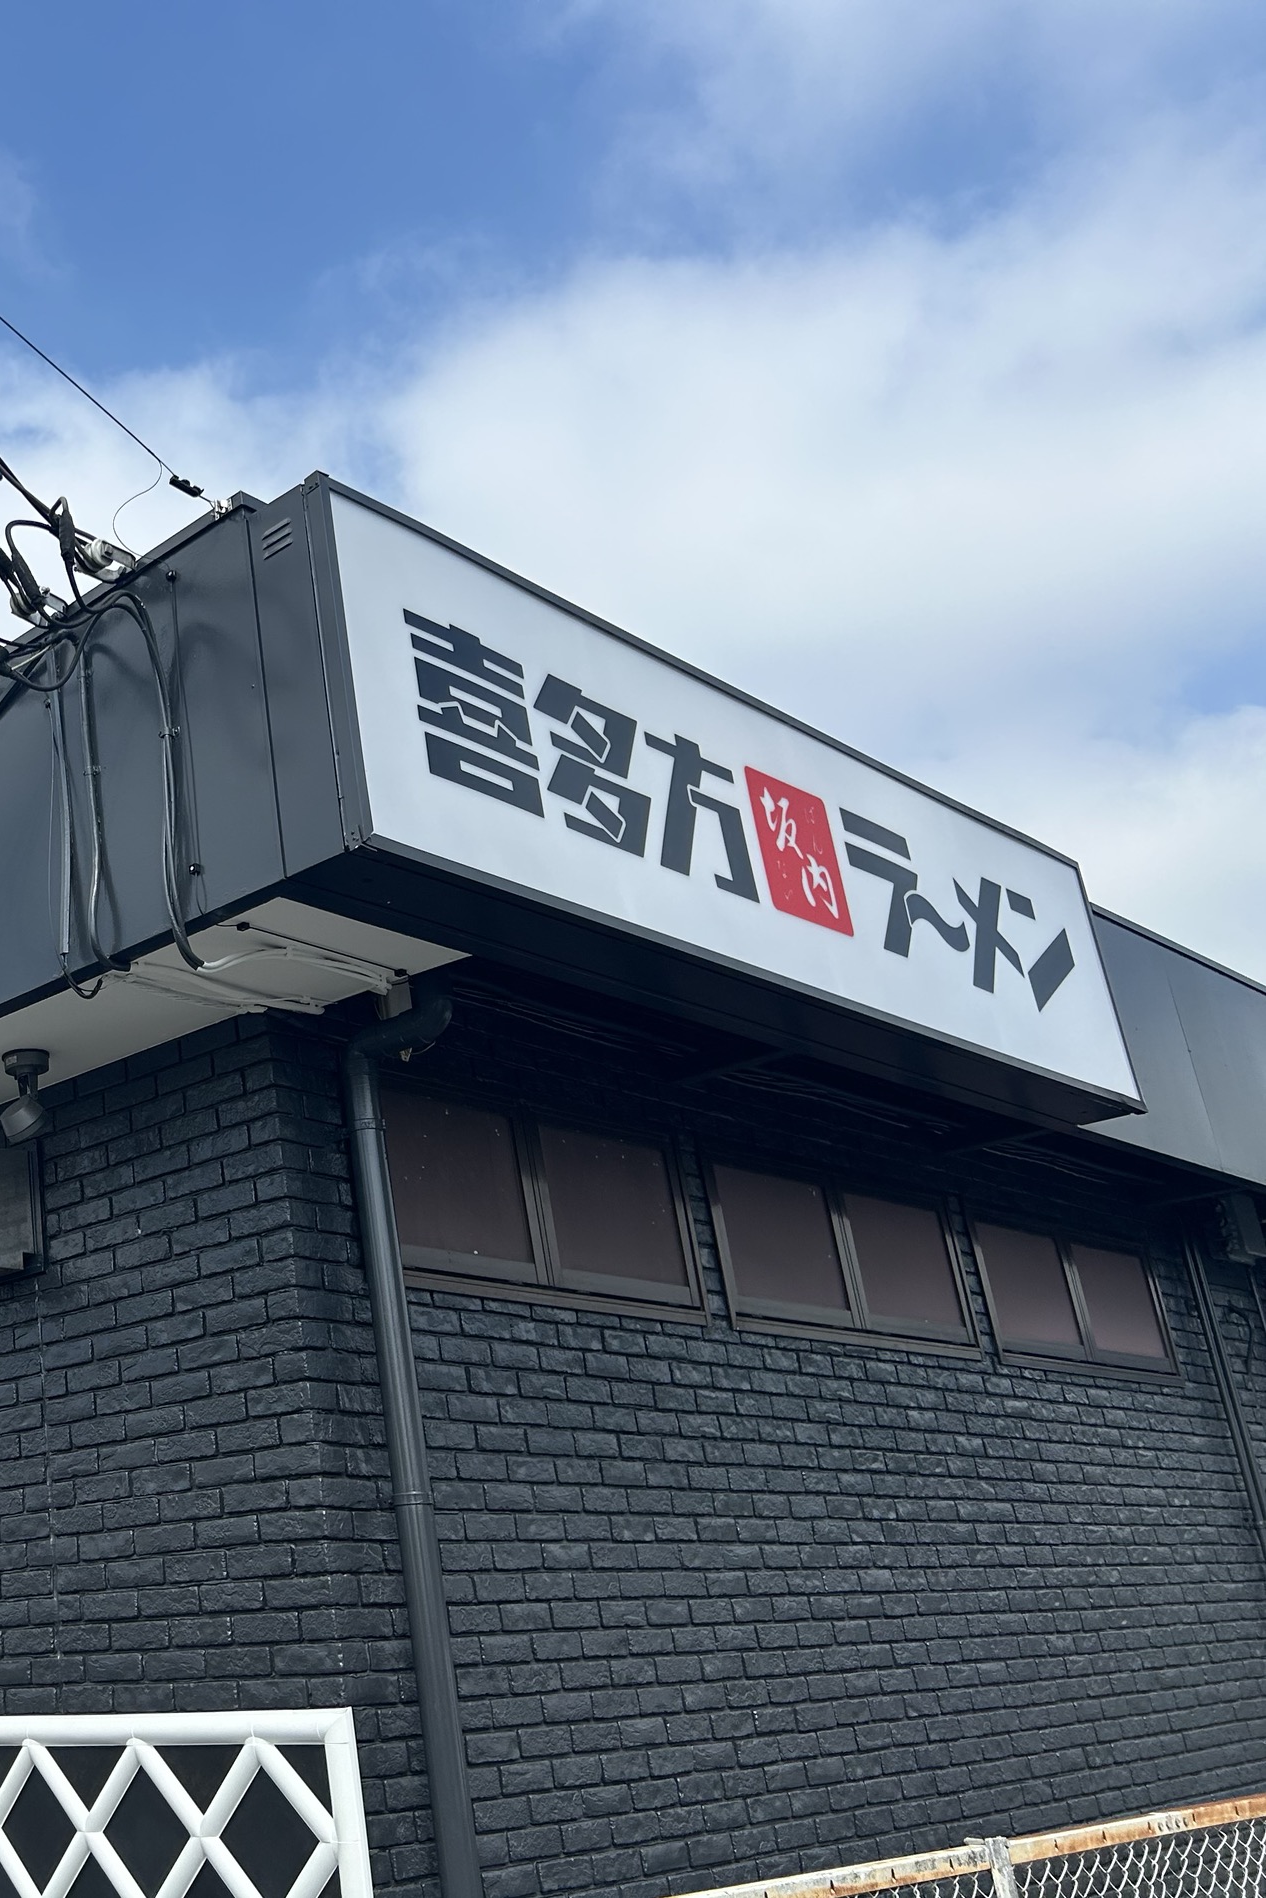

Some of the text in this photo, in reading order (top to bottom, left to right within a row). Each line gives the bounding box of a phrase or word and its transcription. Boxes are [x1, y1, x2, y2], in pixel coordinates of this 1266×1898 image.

[403, 608, 1076, 1012] 喜多方 坂内 ラーメン
